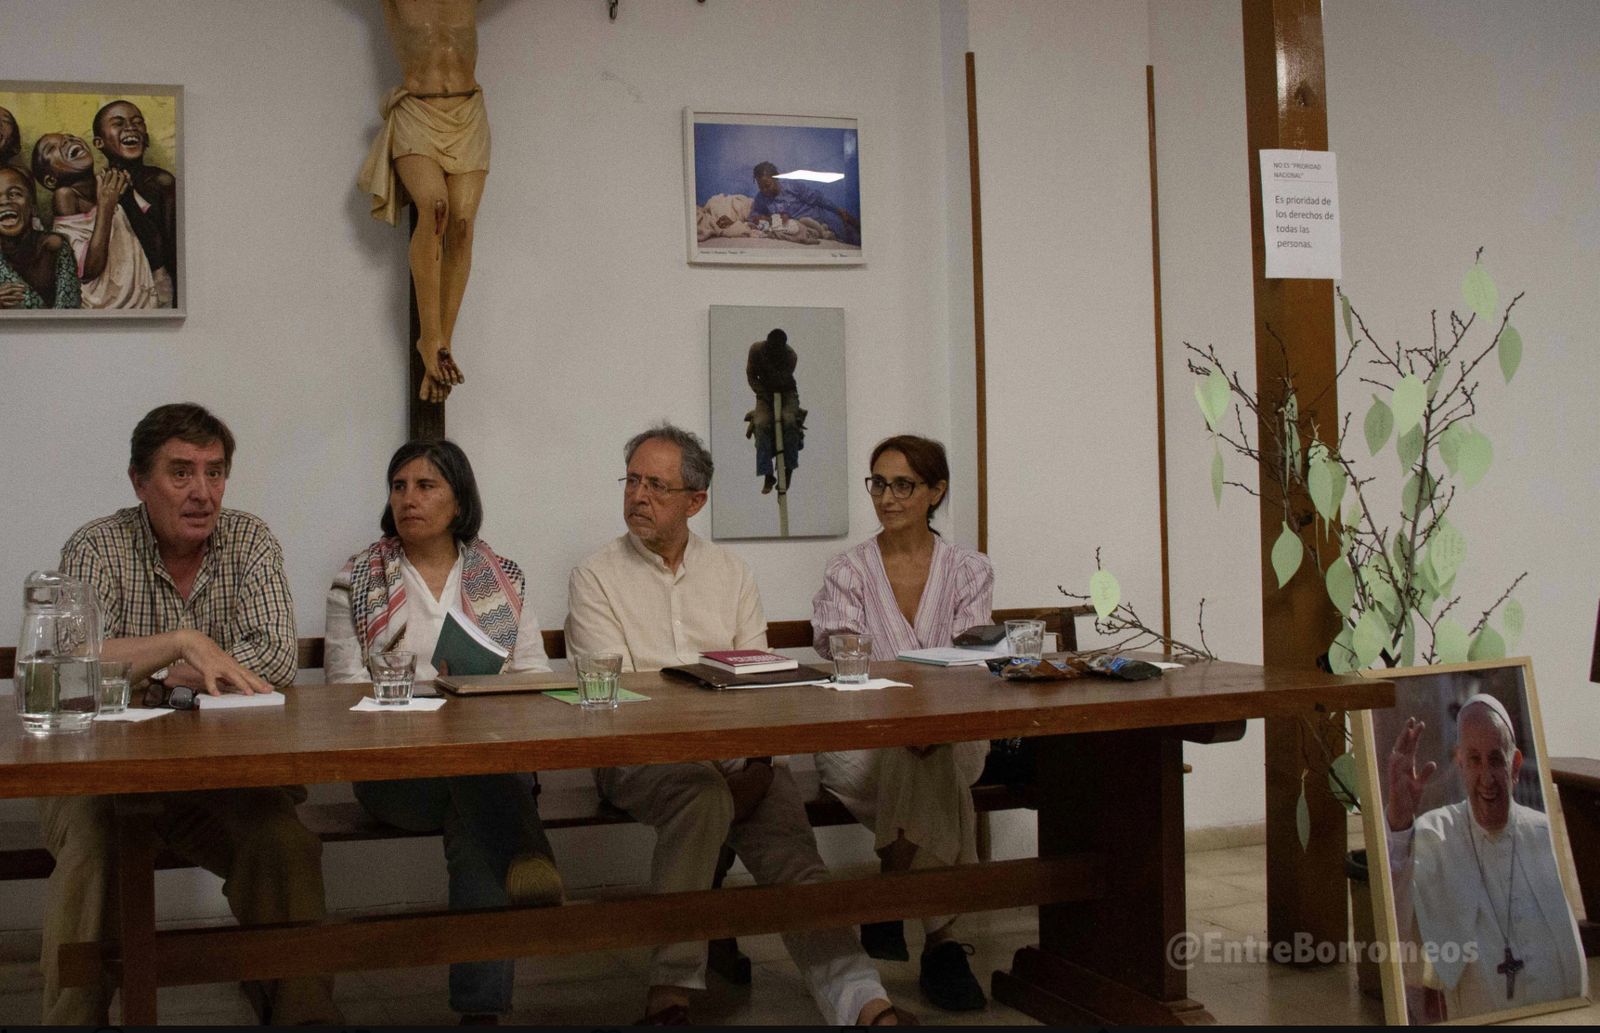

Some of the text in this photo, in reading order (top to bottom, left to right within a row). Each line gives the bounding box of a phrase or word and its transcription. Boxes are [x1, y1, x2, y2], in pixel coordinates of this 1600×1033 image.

[1275, 195, 1332, 206] Es prioridad de
[1275, 209, 1334, 220] los derechos de
[1276, 224, 1310, 234] todas las
[1277, 240, 1312, 249] personas.
